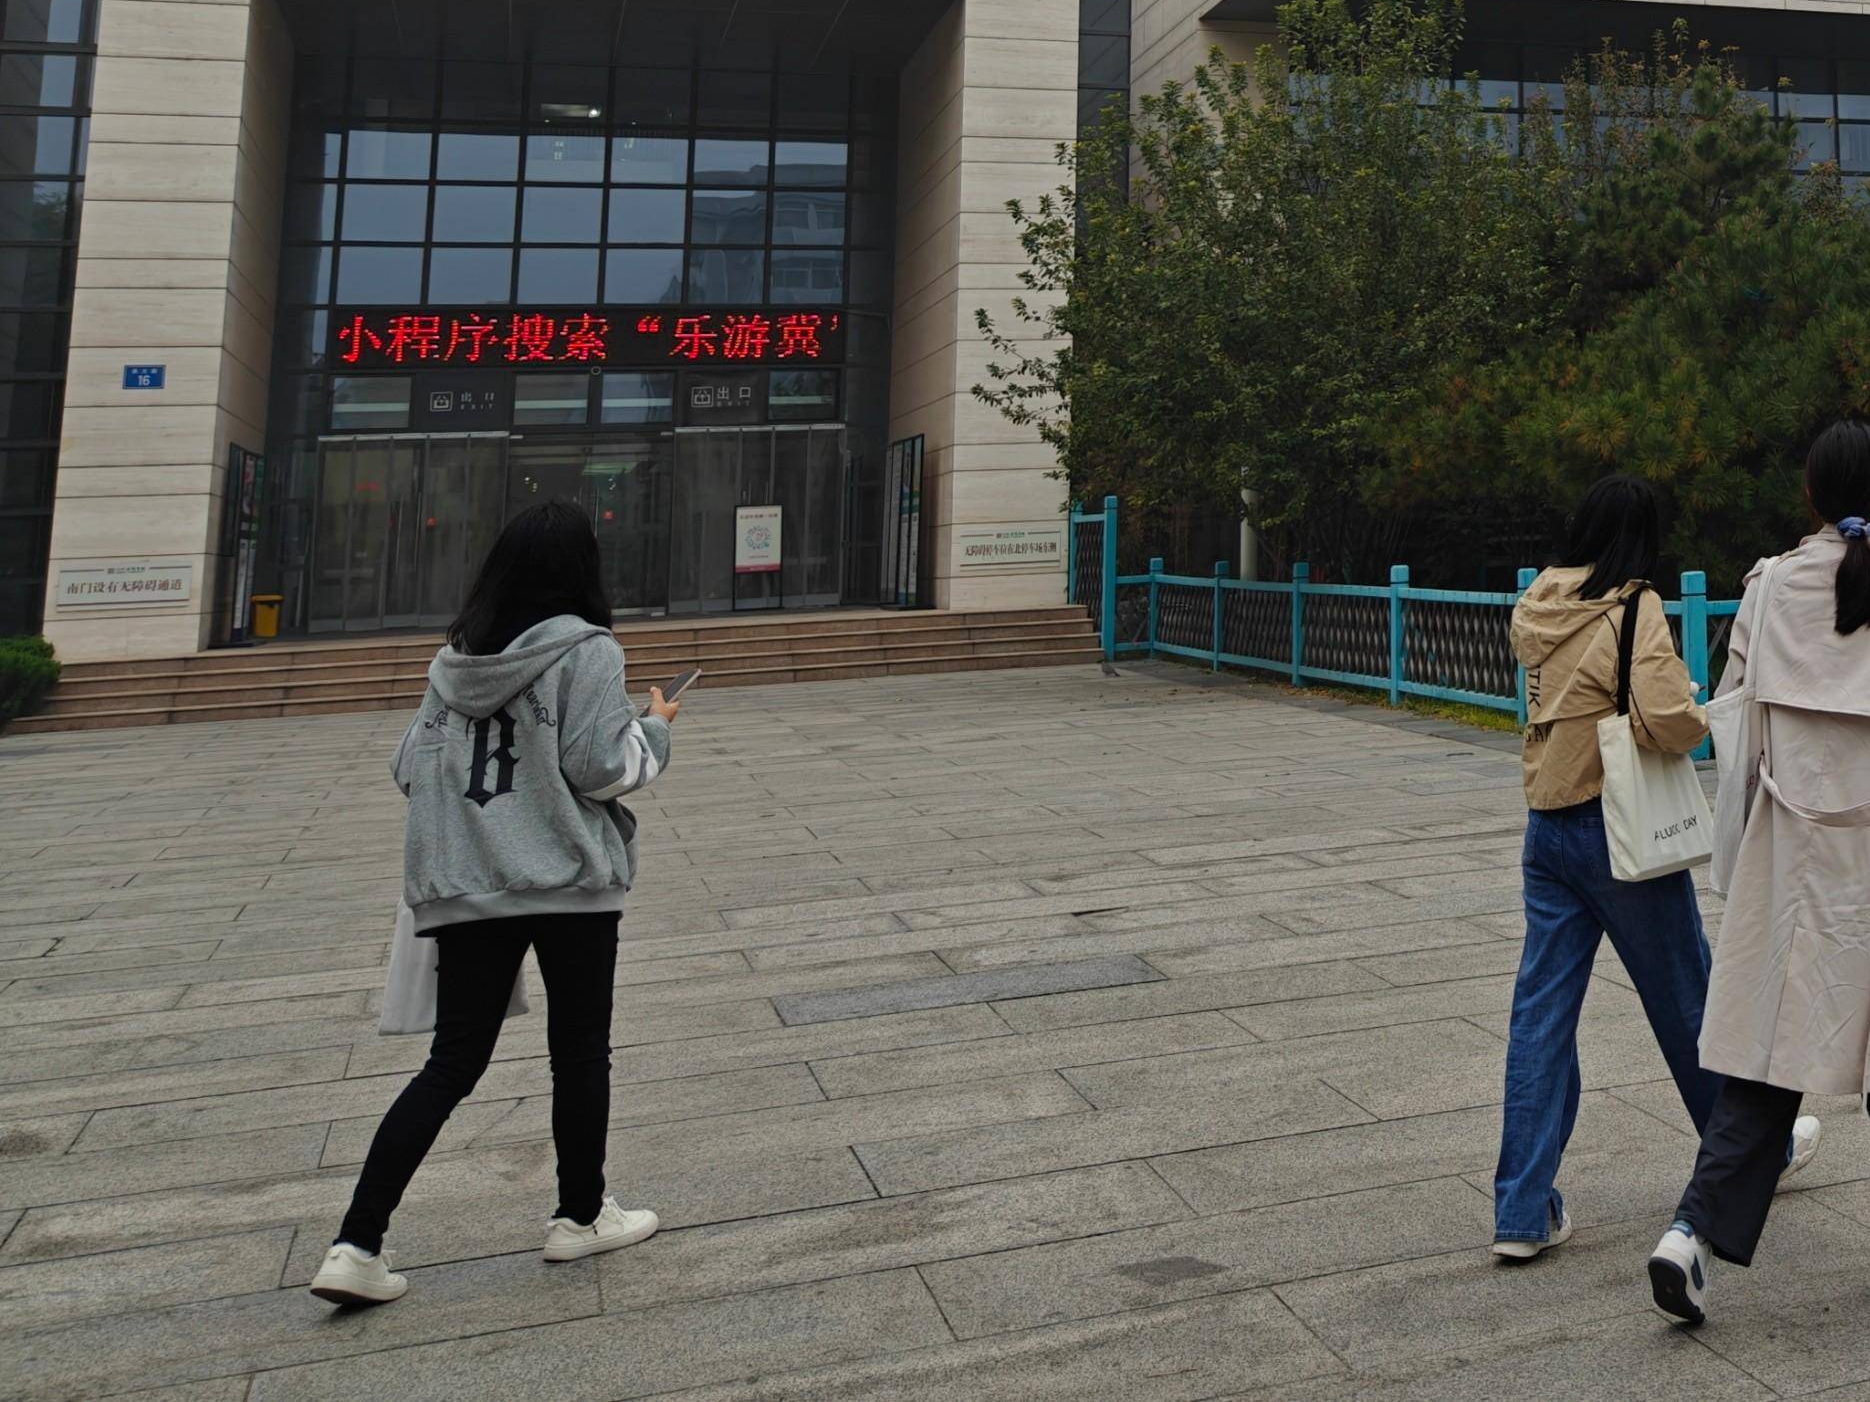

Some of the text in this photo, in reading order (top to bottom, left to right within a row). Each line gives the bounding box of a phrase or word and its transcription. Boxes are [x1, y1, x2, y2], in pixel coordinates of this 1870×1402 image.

[137, 374, 151, 386] 16
[717, 385, 752, 400] 出口
[67, 578, 184, 595] 南门设有无障碍通道
